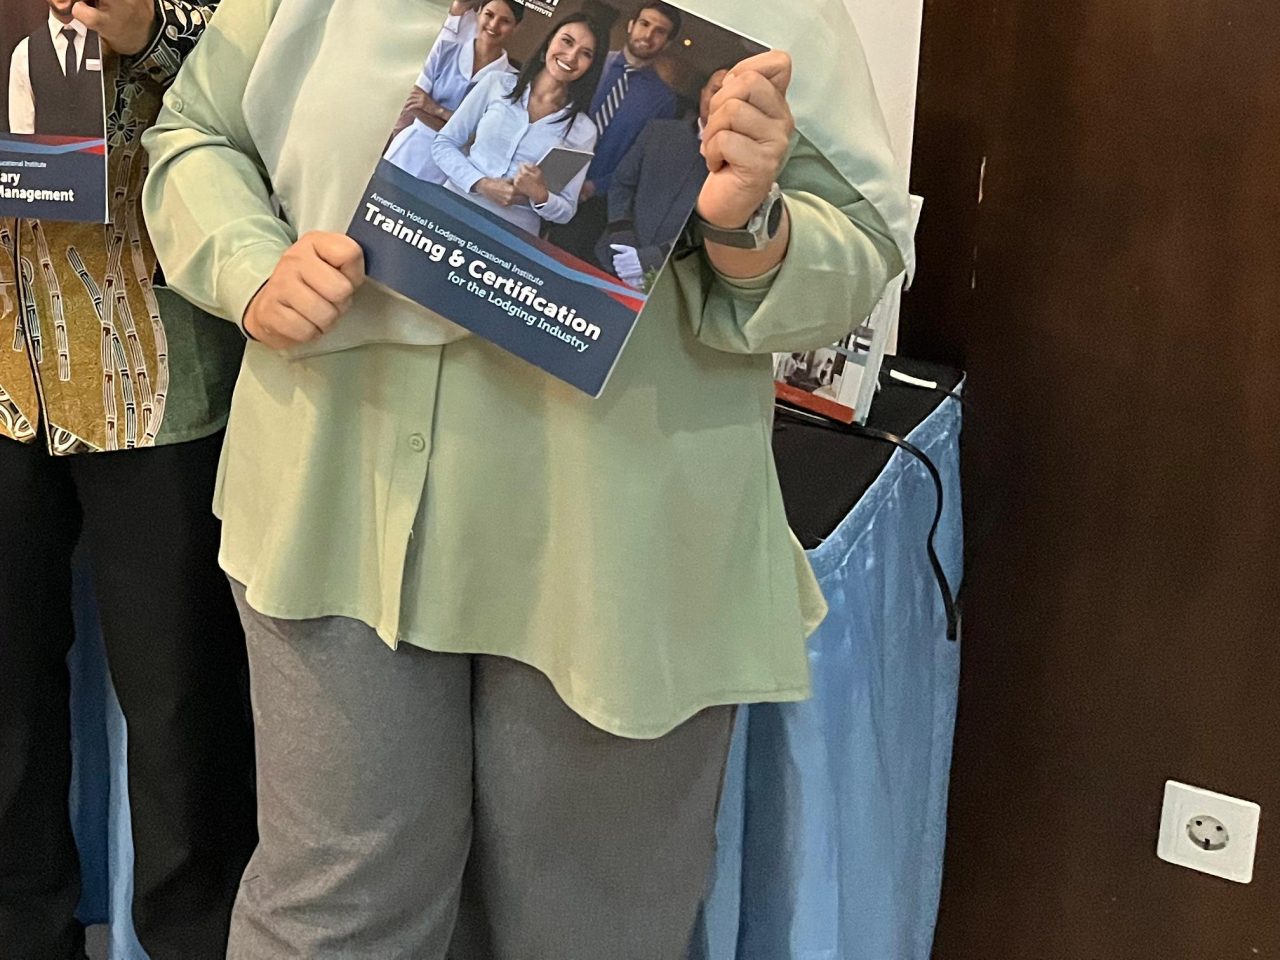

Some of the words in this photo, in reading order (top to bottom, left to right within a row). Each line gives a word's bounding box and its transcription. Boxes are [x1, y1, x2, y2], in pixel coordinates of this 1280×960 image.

[364, 202, 447, 262] Training
[448, 249, 466, 268] &
[468, 259, 602, 341] Certification
[370, 192, 406, 216] American
[406, 210, 428, 227] Hotel
[434, 225, 466, 248] Lodging
[466, 241, 512, 270] Educational
[511, 264, 544, 286] Institute
[447, 271, 466, 287] for
[466, 281, 486, 299] the
[487, 291, 537, 327] Lodging
[537, 317, 589, 353] Industry
